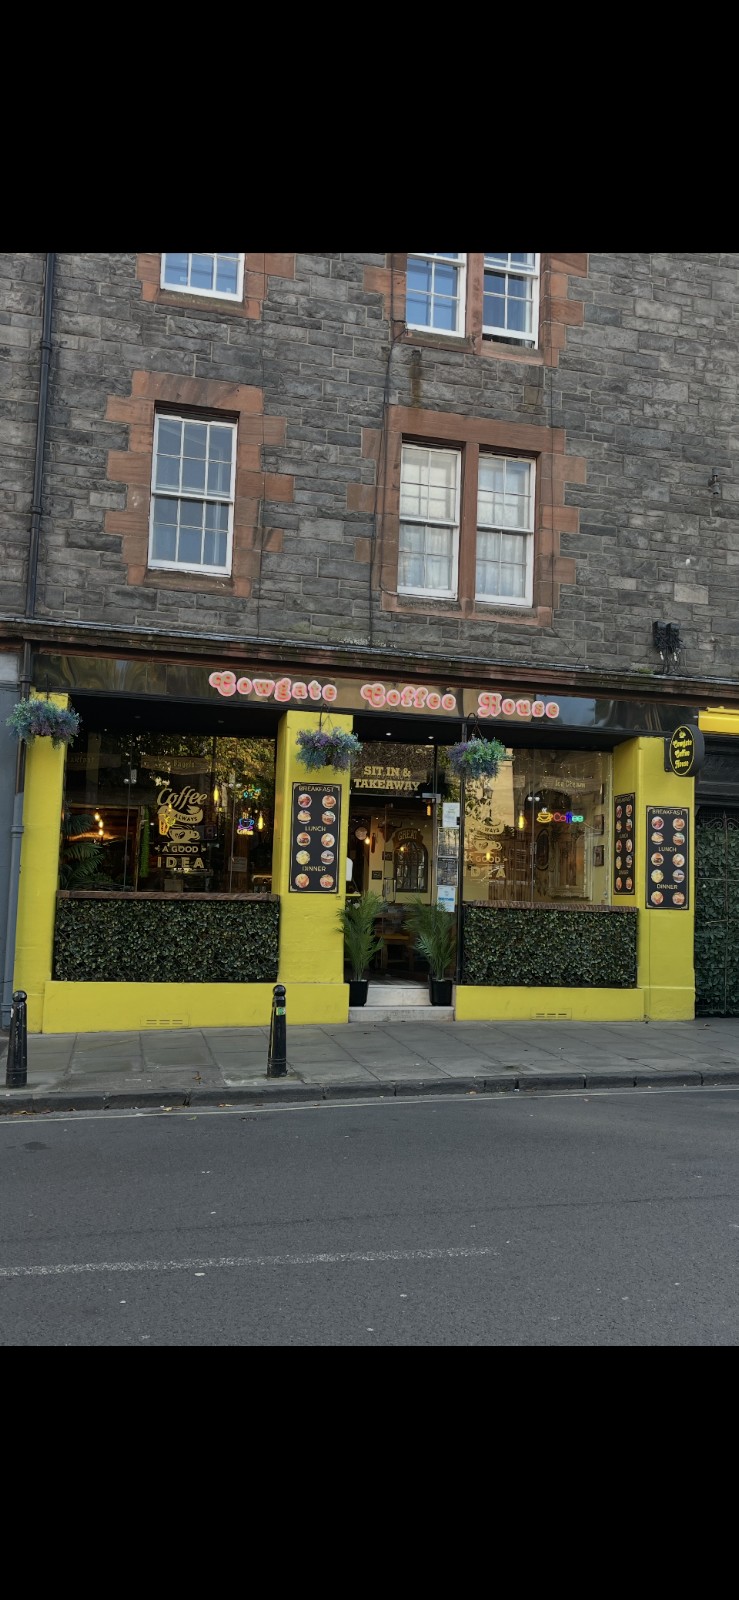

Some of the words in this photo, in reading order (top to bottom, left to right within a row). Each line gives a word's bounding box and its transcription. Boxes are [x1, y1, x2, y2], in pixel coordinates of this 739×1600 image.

[209, 671, 337, 702] Cowgate
[360, 683, 456, 711] Coffee
[477, 692, 560, 718] House
[364, 765, 384, 776] SIT
[386, 766, 401, 777] IN
[402, 767, 412, 778] &
[298, 785, 335, 793] BREAKFAST
[354, 778, 420, 791] TAKEAWAY
[157, 786, 208, 810] Coffee
[174, 813, 198, 822] ALWAYS
[553, 811, 584, 824] Coffee
[398, 829, 418, 841] GREAT
[162, 845, 169, 853] A
[171, 845, 199, 853] GOOD
[157, 856, 205, 869] IDEA
[475, 855, 501, 864] GOOD
[302, 865, 327, 873] DINNER
